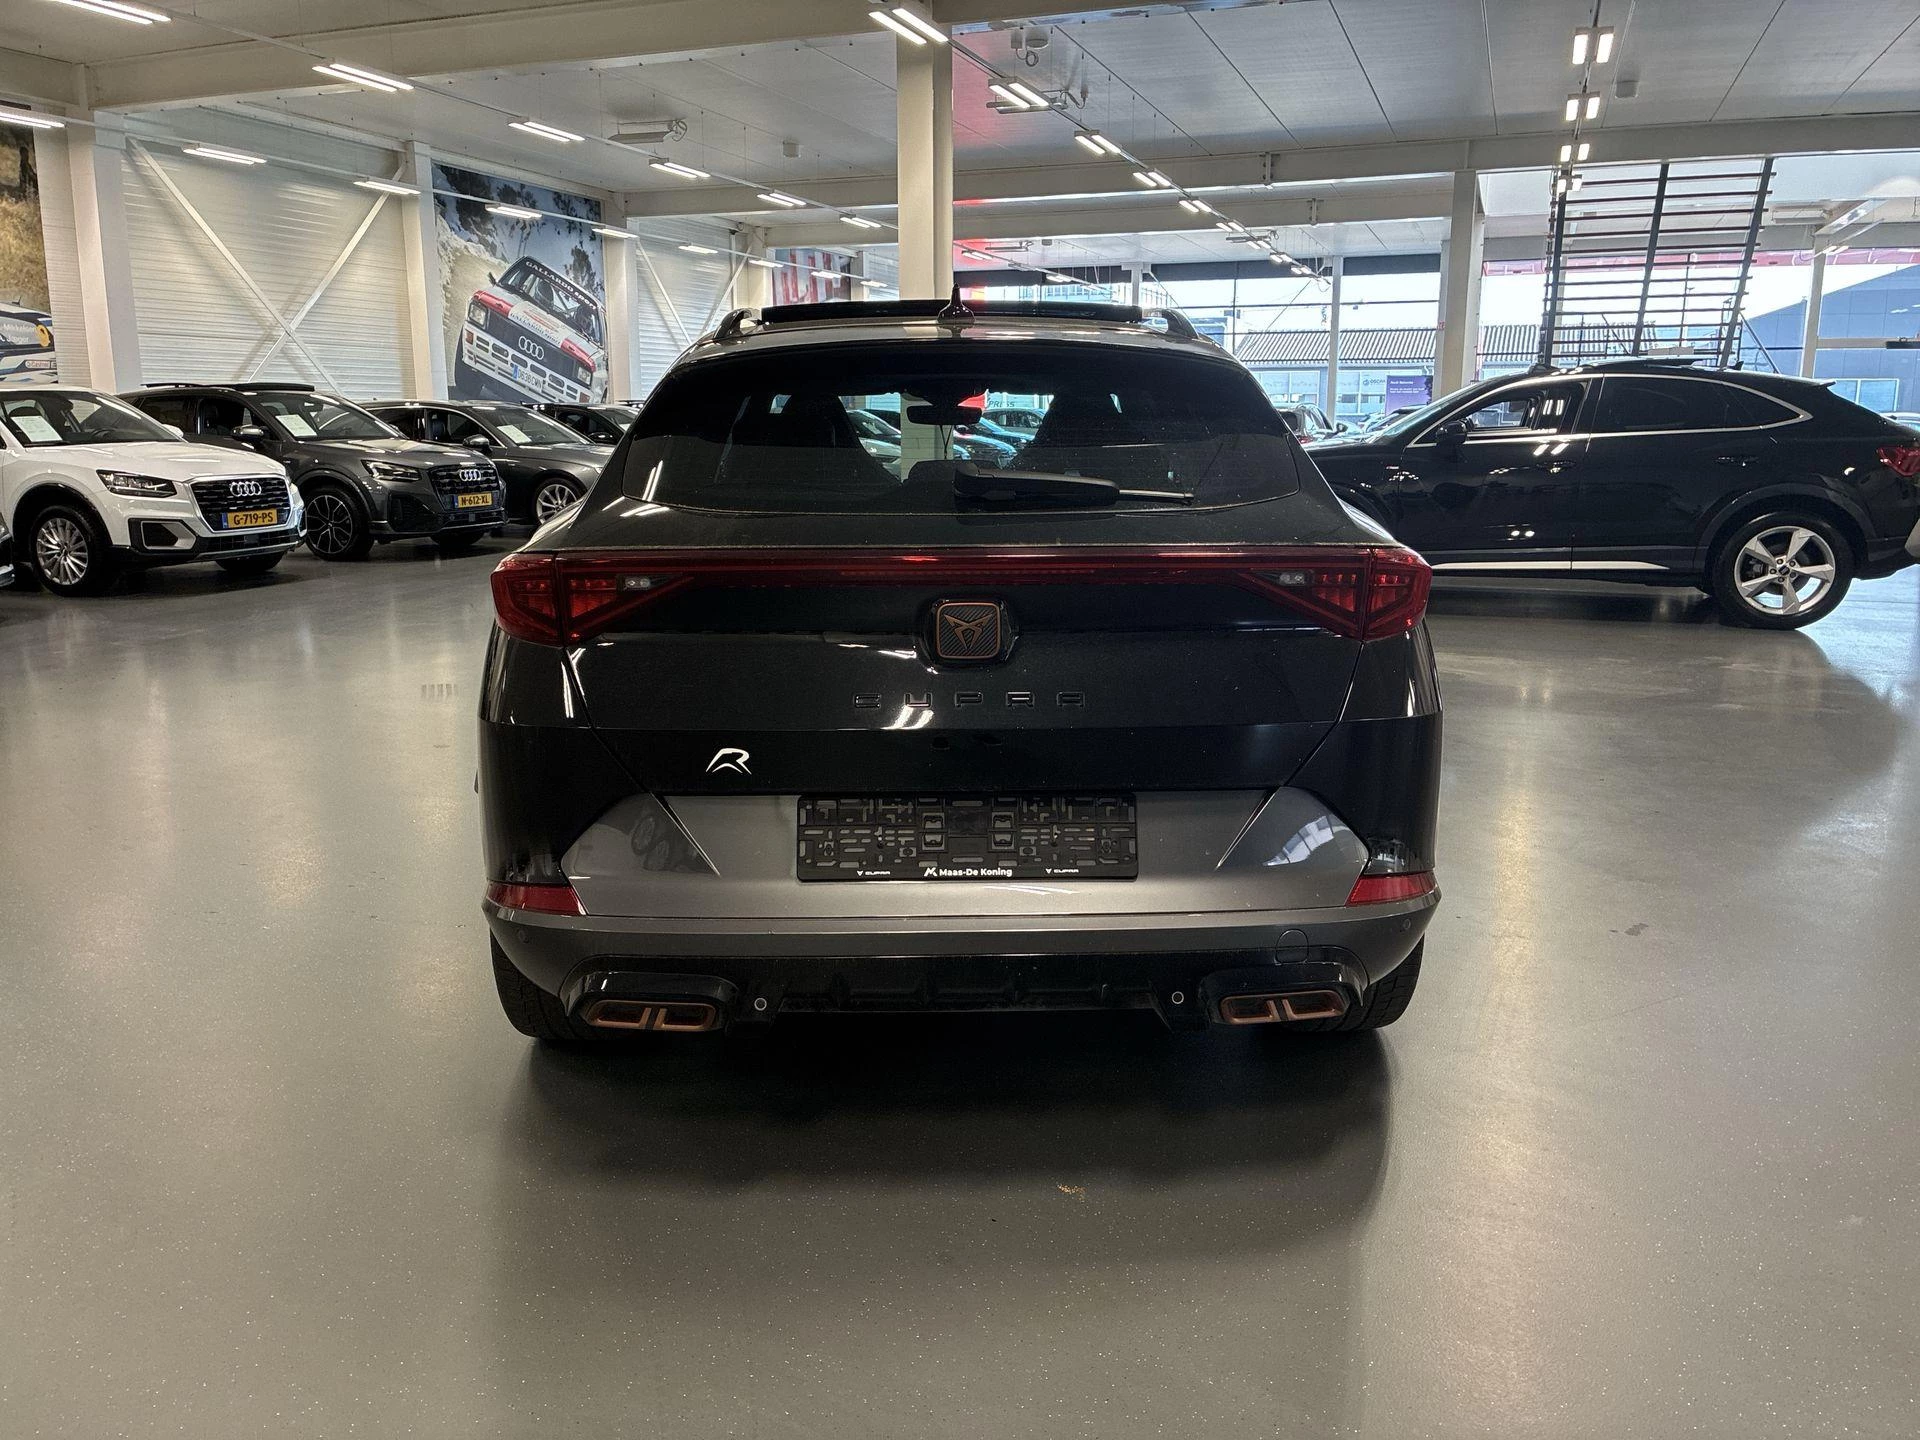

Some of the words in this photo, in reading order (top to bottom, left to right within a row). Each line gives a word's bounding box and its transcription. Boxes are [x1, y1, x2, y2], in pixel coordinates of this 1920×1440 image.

[525, 261, 574, 292] GALLARDO
[461, 495, 489, 506] N-612-XL
[233, 512, 273, 525] G-719-PS
[854, 691, 1085, 708] CUPRA
[939, 868, 979, 876] Maas-De
[980, 867, 1013, 877] Koning
